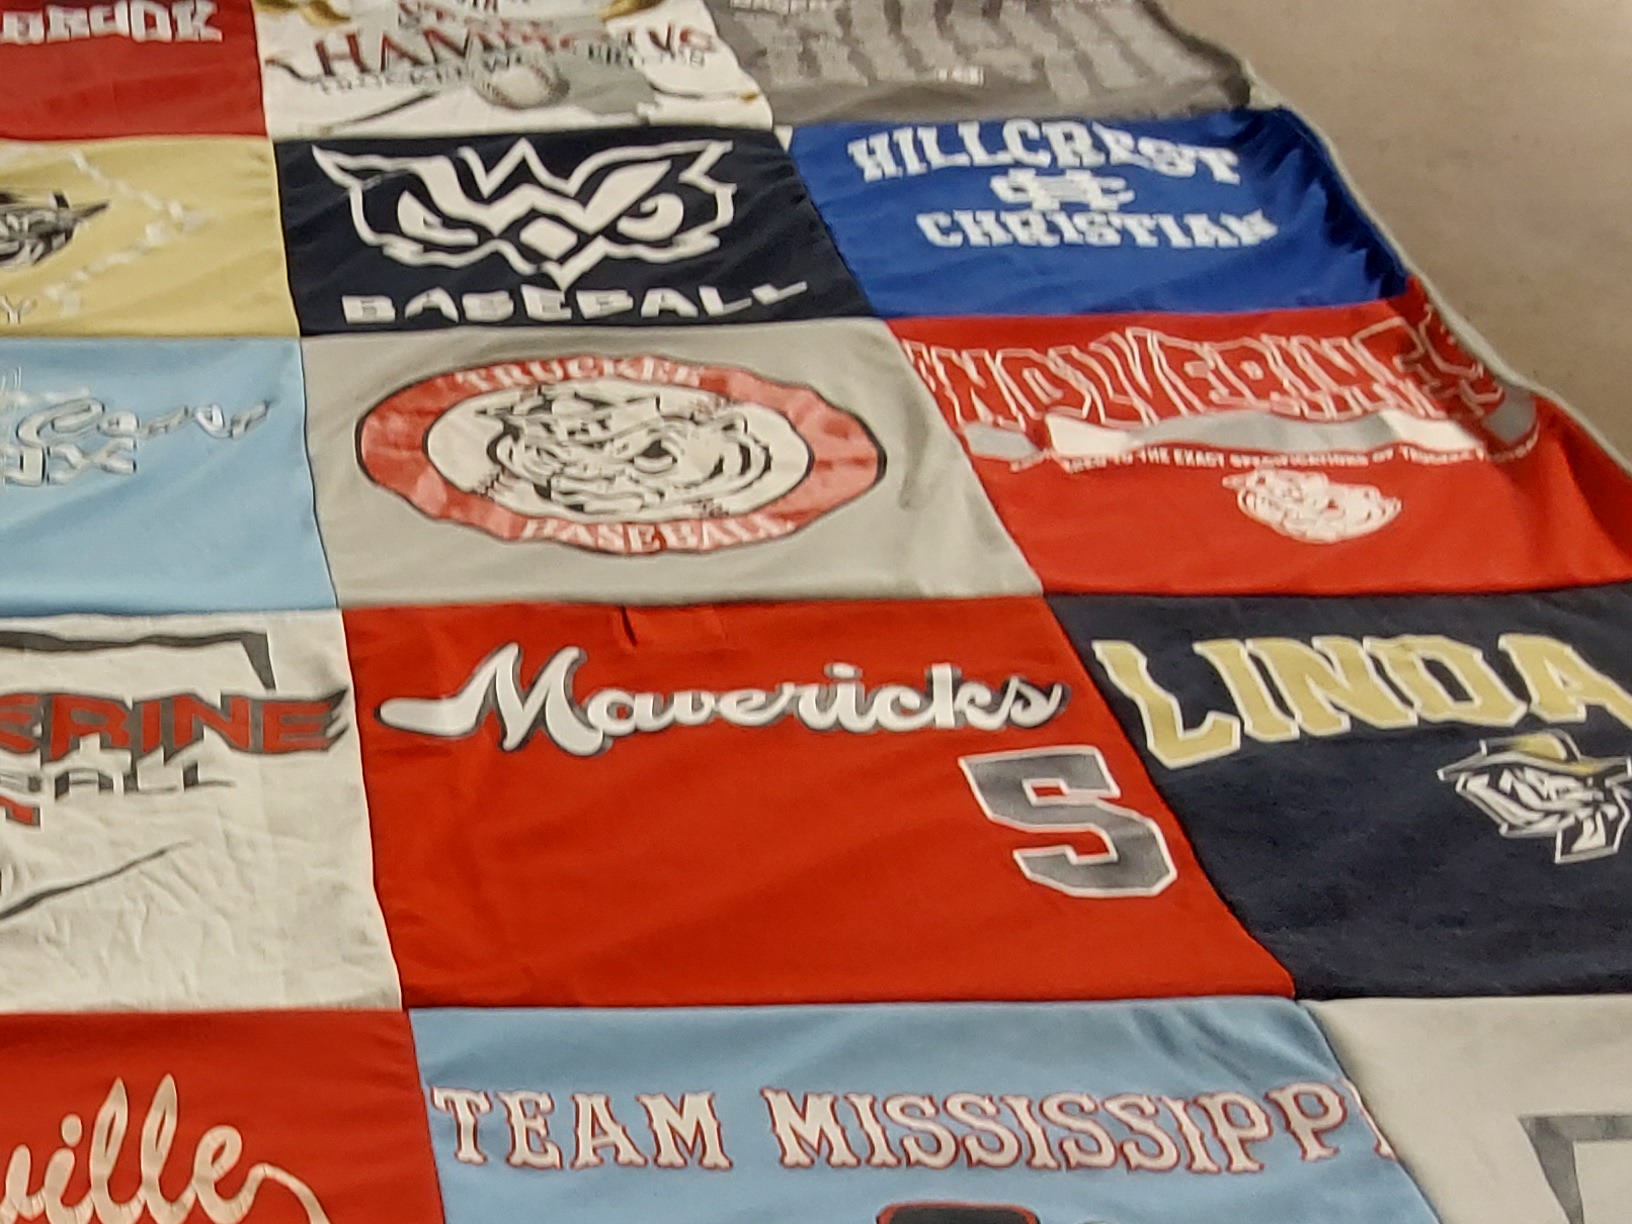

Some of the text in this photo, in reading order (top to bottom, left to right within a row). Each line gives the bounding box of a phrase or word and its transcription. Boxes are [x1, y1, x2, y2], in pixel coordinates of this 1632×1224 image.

[847, 118, 1241, 184] HILLCREST
[916, 208, 1279, 249] CHRISTIAN
[341, 281, 808, 325] BASEBALL
[372, 639, 1073, 756] Mavericks
[1090, 633, 1632, 769] LINDA
[958, 745, 1178, 898] 5
[429, 1085, 733, 1171] TEAM
